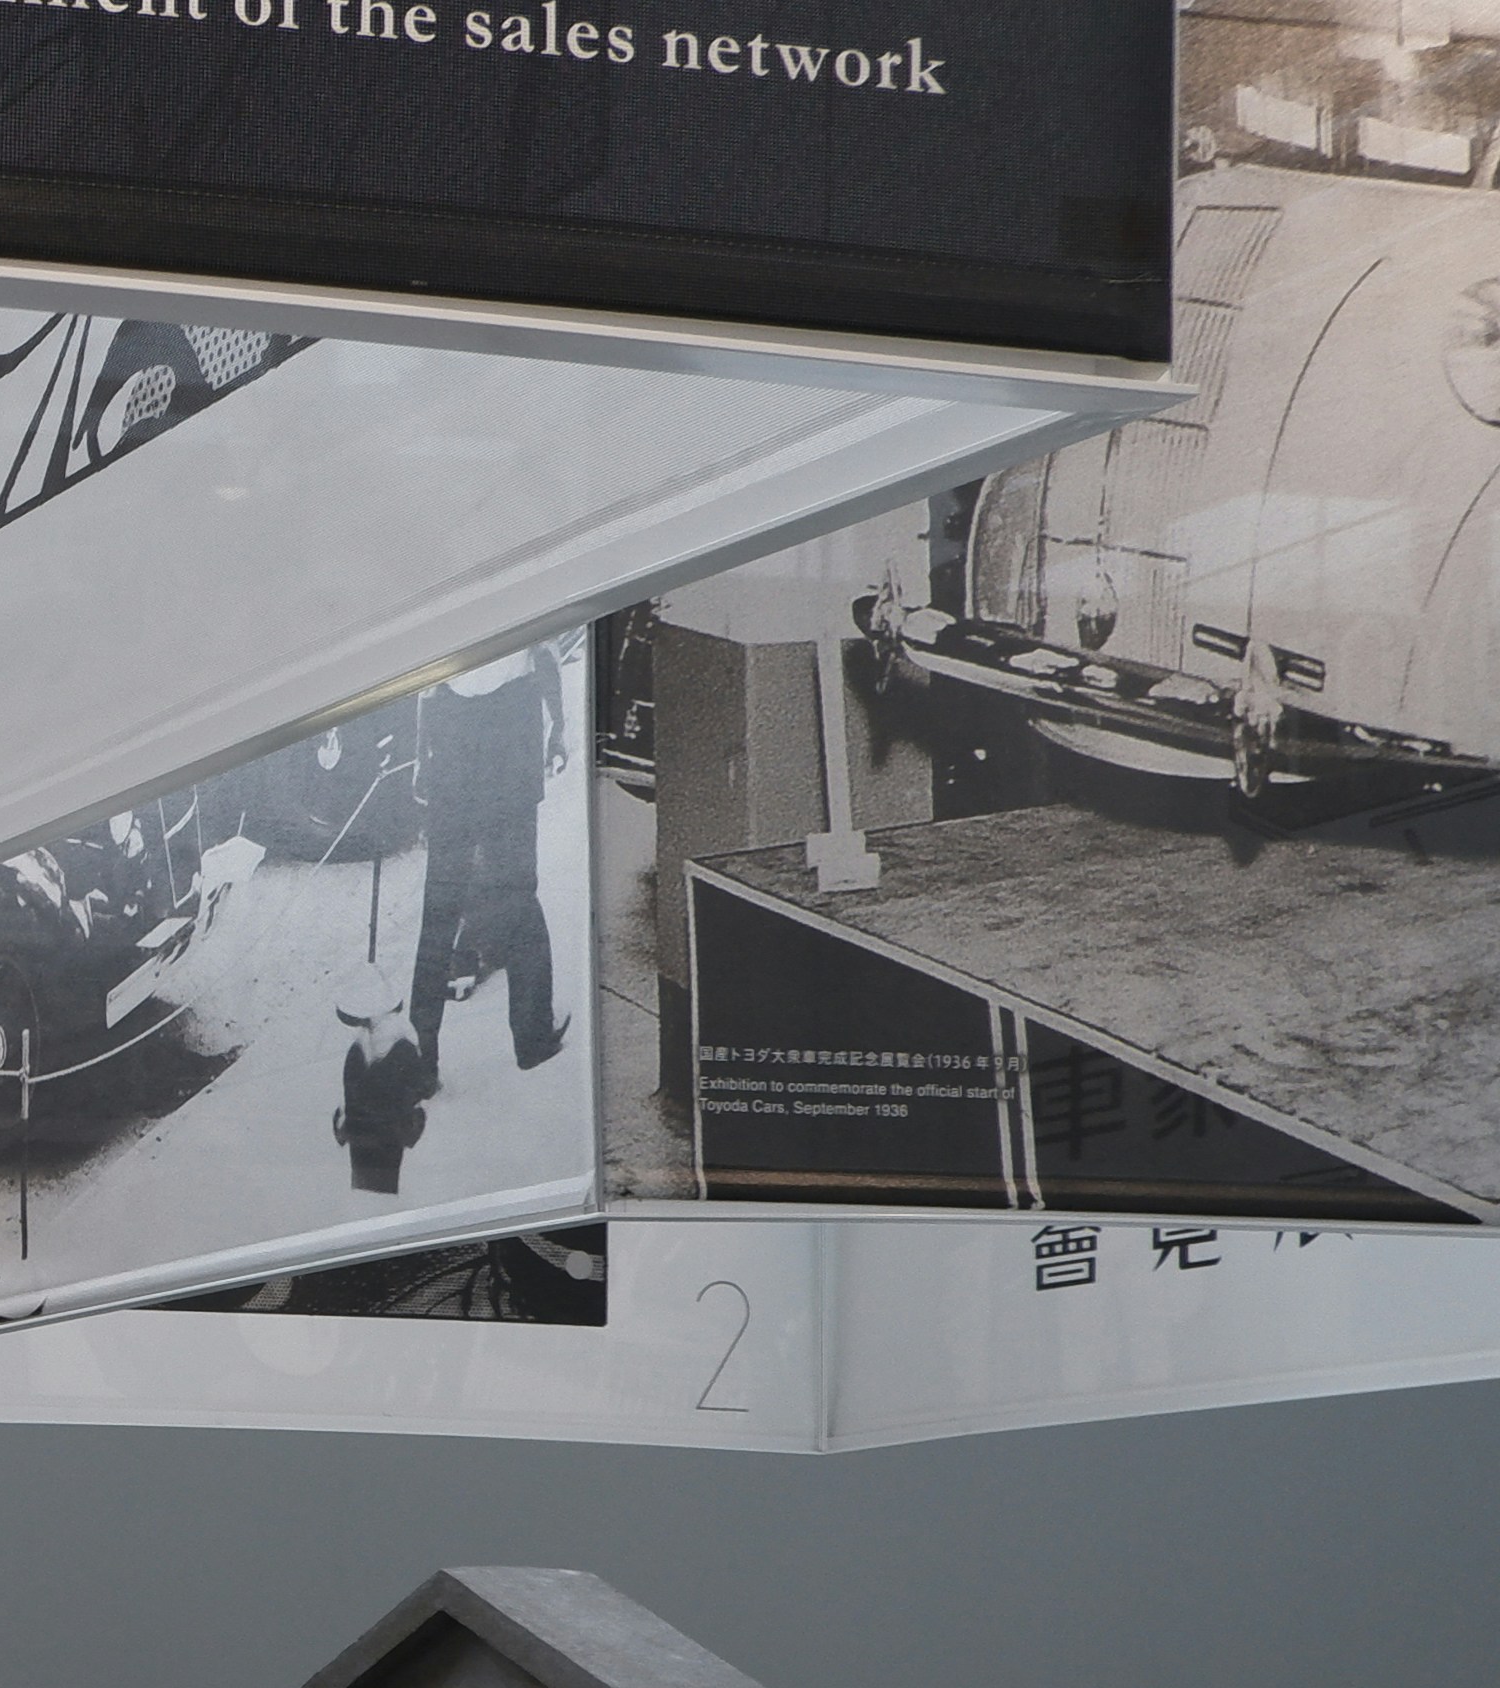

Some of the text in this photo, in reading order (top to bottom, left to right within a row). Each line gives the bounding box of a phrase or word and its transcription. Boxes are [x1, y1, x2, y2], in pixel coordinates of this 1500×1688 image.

[326, 0, 437, 43] the
[464, 0, 635, 63] sales
[661, 29, 948, 95] network
[700, 1076, 1016, 1100] Exhibition to commemorate the official start of
[700, 1097, 909, 1119] Toyoda Cars, September 1936
[695, 1280, 750, 1413] 2
